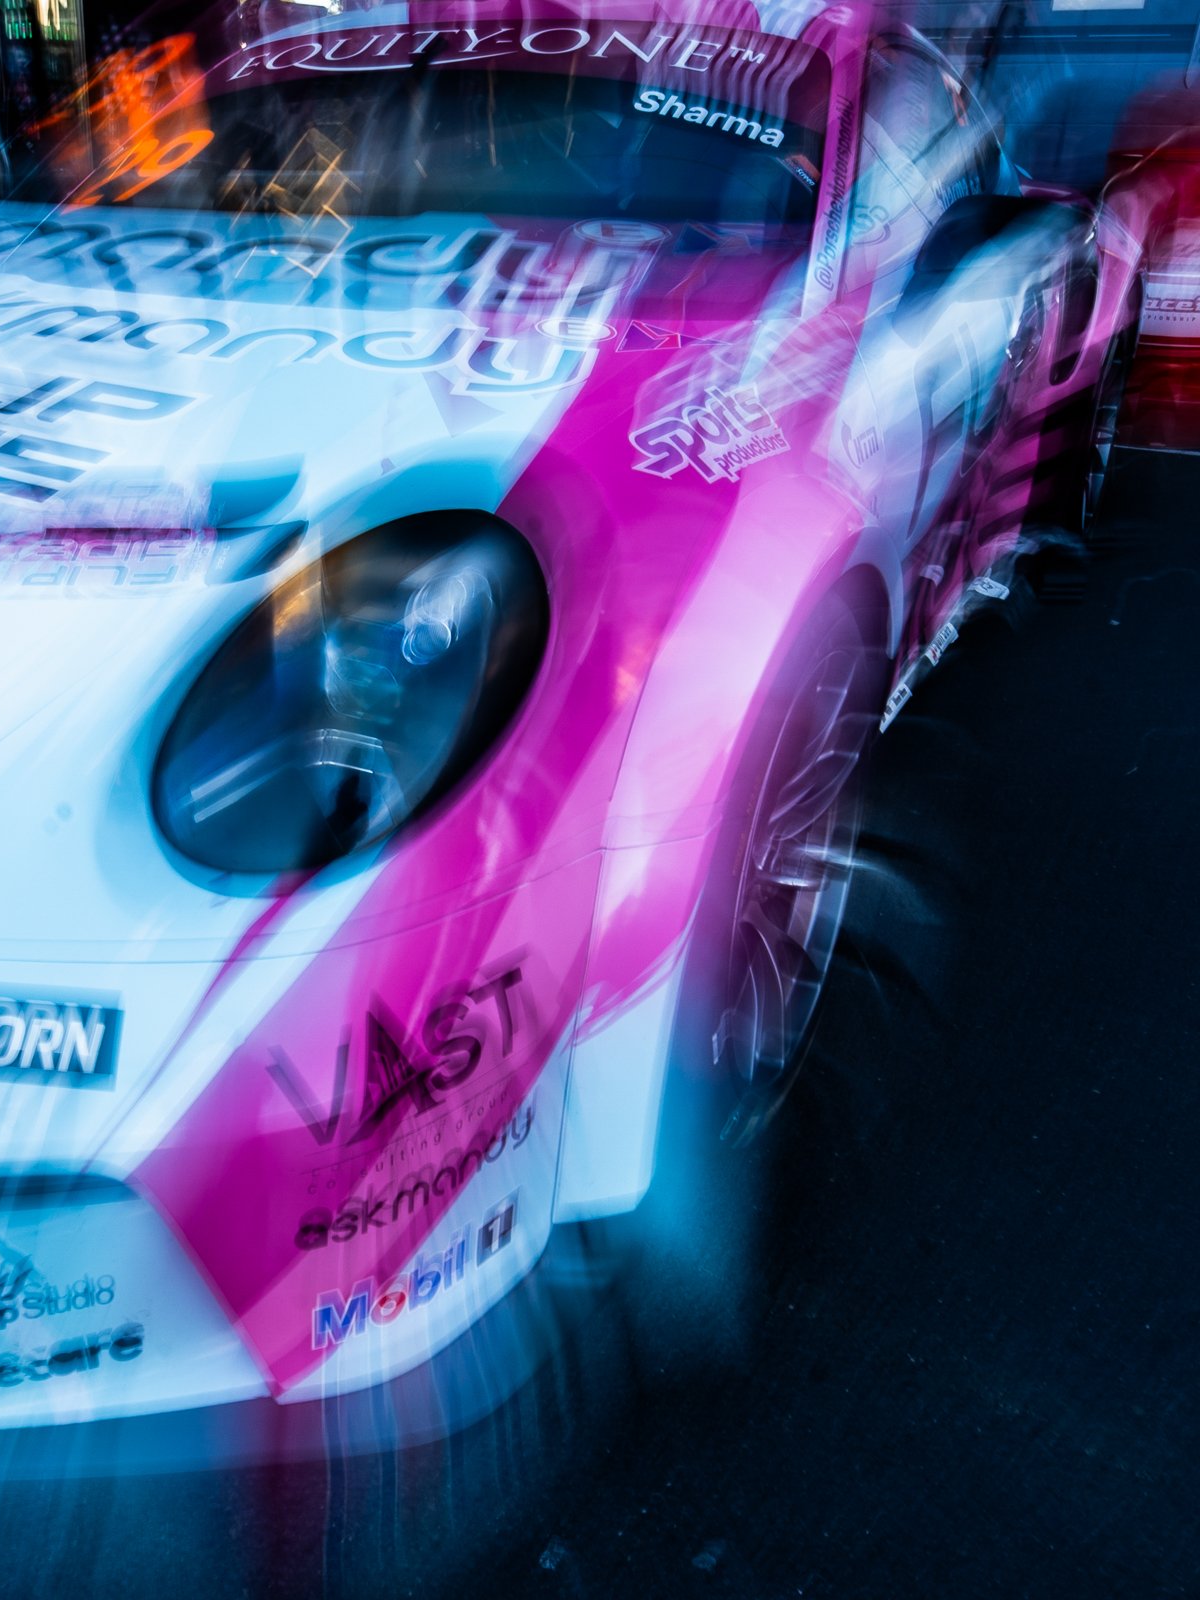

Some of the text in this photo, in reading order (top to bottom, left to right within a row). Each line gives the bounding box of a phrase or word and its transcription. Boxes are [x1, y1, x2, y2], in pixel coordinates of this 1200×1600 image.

[632, 89, 786, 149] Sharma
[713, 432, 788, 481] productions
[265, 955, 525, 1147] VAST
[311, 1238, 469, 1350] Mobil
